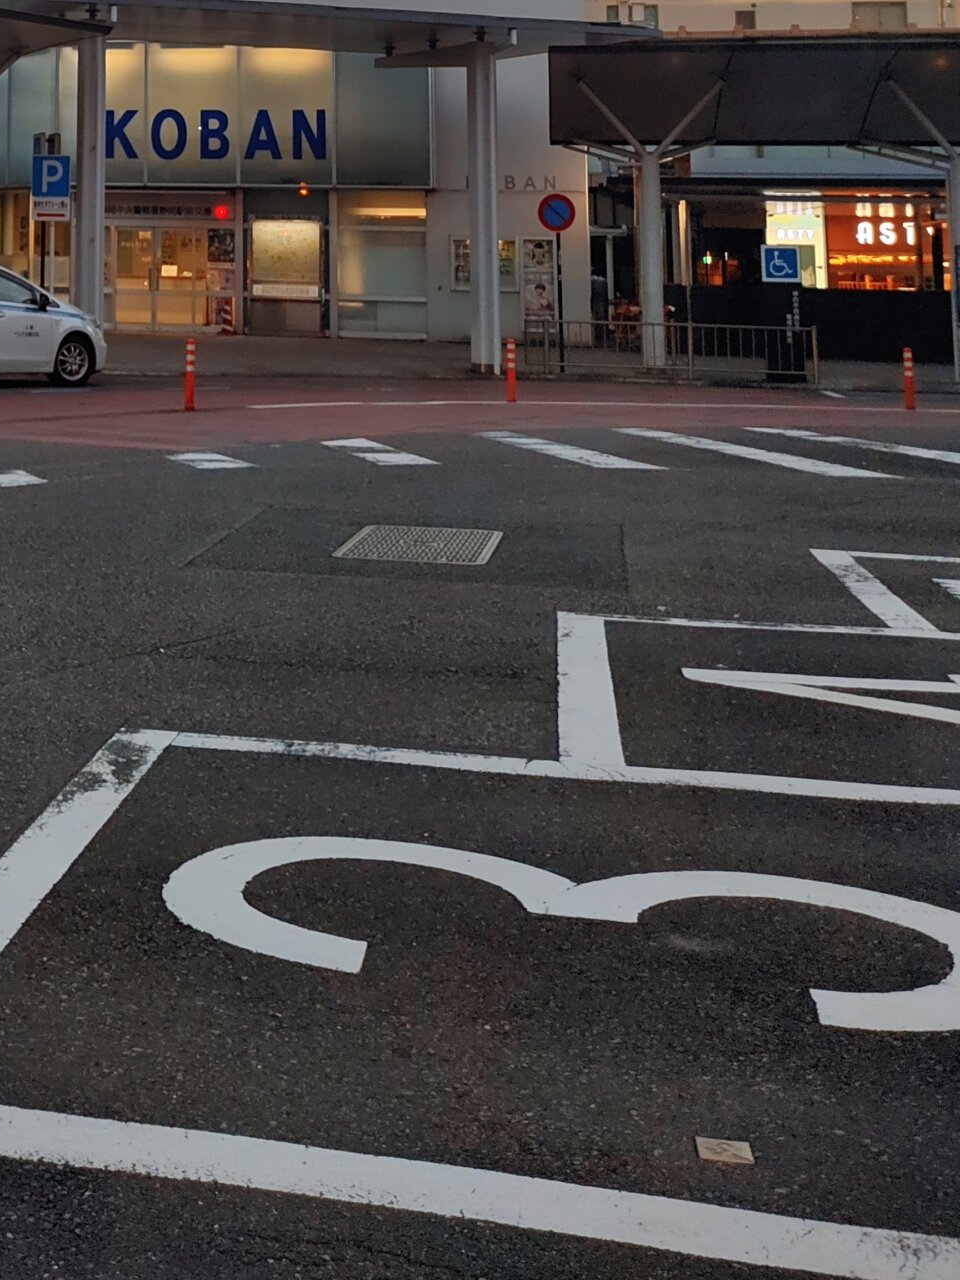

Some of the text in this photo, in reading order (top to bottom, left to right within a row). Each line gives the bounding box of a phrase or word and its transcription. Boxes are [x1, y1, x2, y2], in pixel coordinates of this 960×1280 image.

[105, 109, 327, 160] KOBAN
[42, 160, 63, 193] P
[162, 836, 960, 1034] 3
